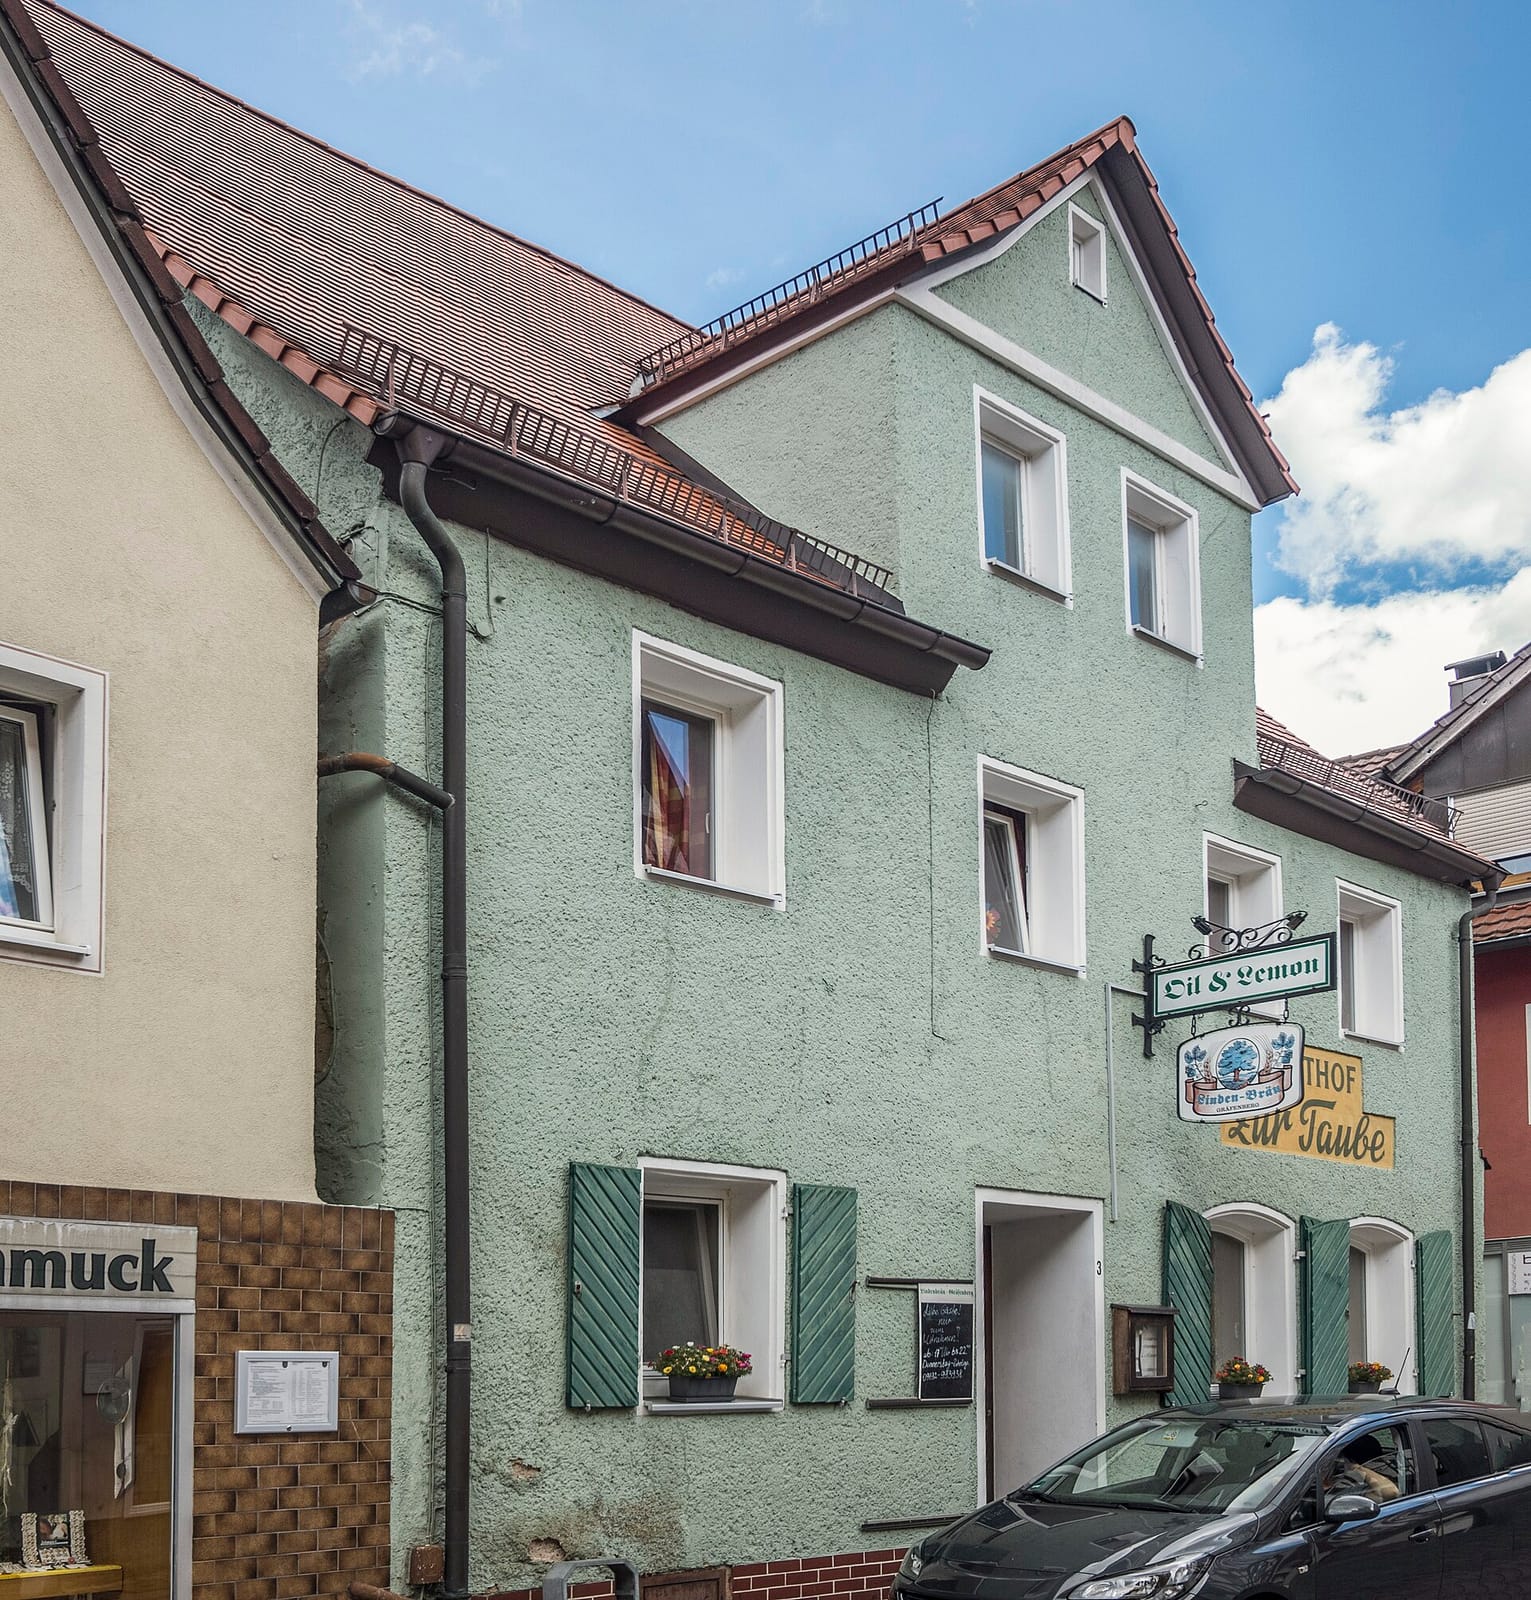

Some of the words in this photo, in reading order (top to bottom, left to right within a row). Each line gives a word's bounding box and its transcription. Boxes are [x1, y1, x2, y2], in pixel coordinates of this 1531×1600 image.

[1164, 975, 1200, 1000] Oil
[1208, 971, 1231, 993] &
[1237, 957, 1320, 986] Lemon
[1197, 1085, 1281, 1105] Linden-Bräu
[1304, 1056, 1356, 1094] THOF
[1298, 1099, 1385, 1163] Taube
[0, 1238, 175, 1293] muck
[1096, 1260, 1102, 1276] 3
